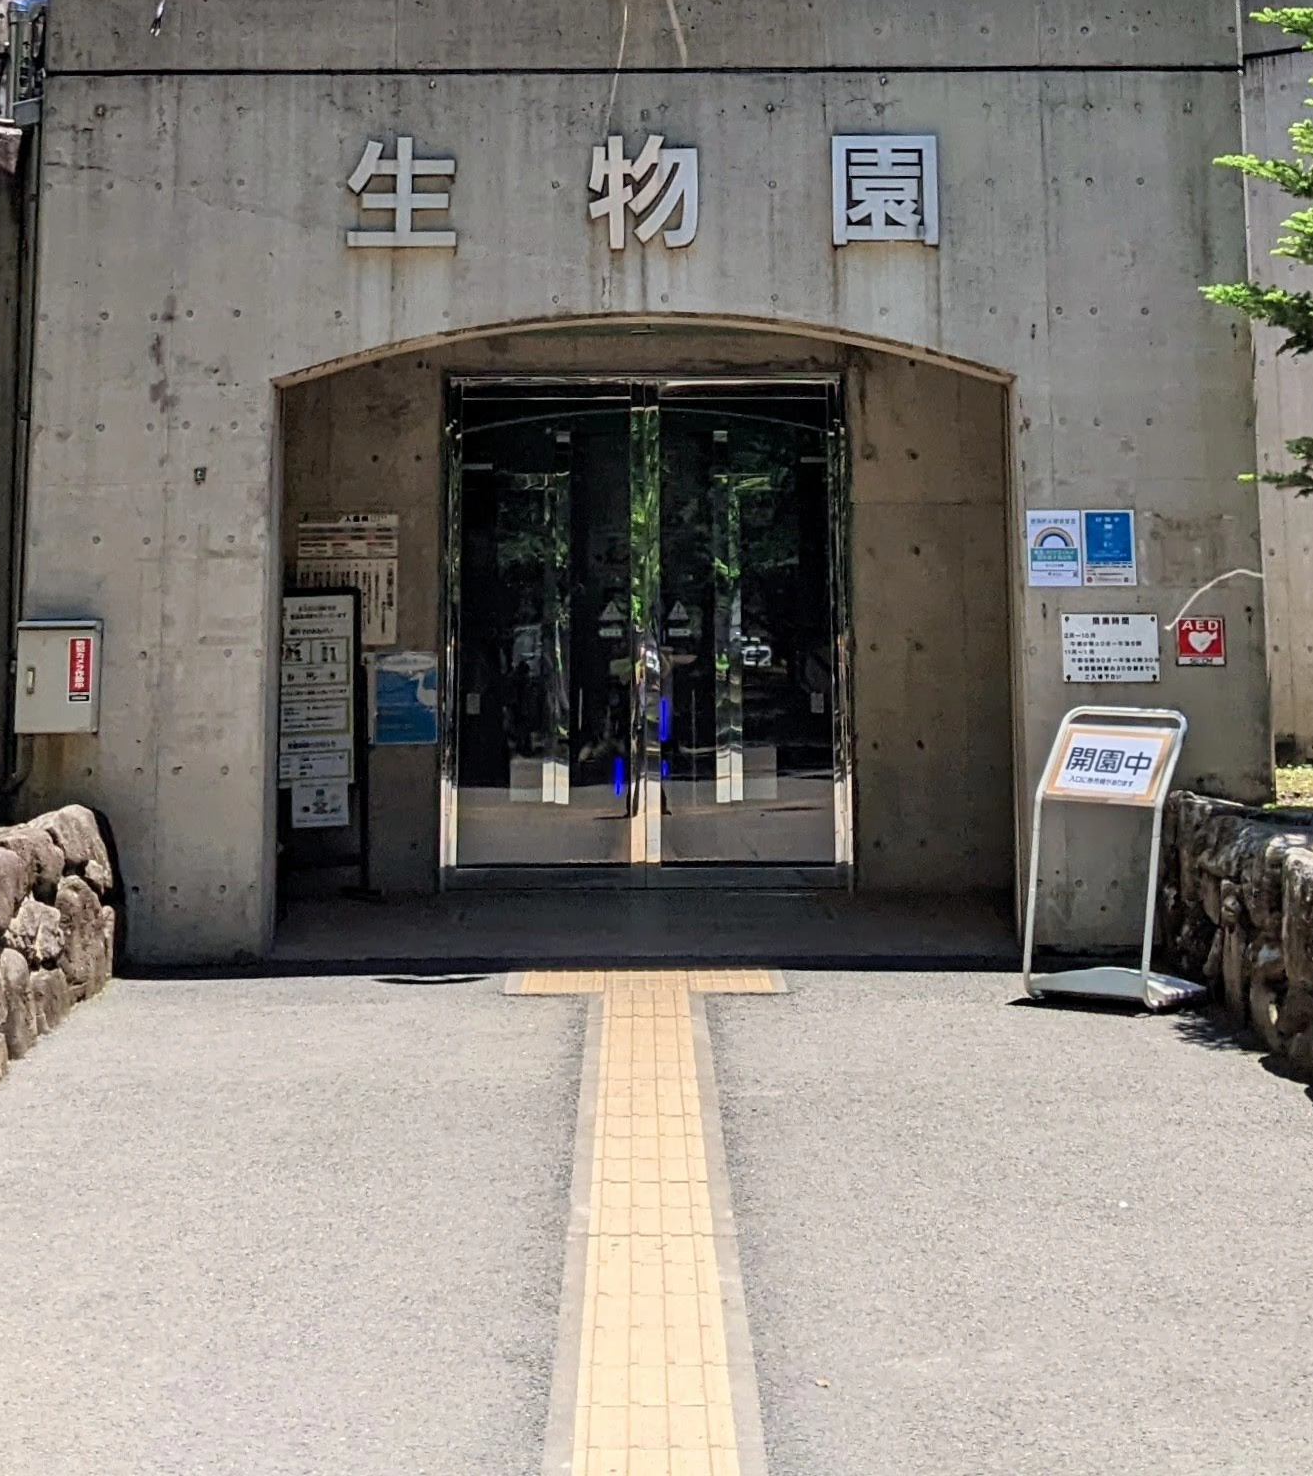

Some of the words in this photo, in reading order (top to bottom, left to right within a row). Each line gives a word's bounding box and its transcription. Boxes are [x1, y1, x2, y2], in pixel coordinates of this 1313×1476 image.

[347, 134, 939, 250] 生物園
[1181, 620, 1219, 631] AED
[1065, 746, 1153, 776] 開園中
